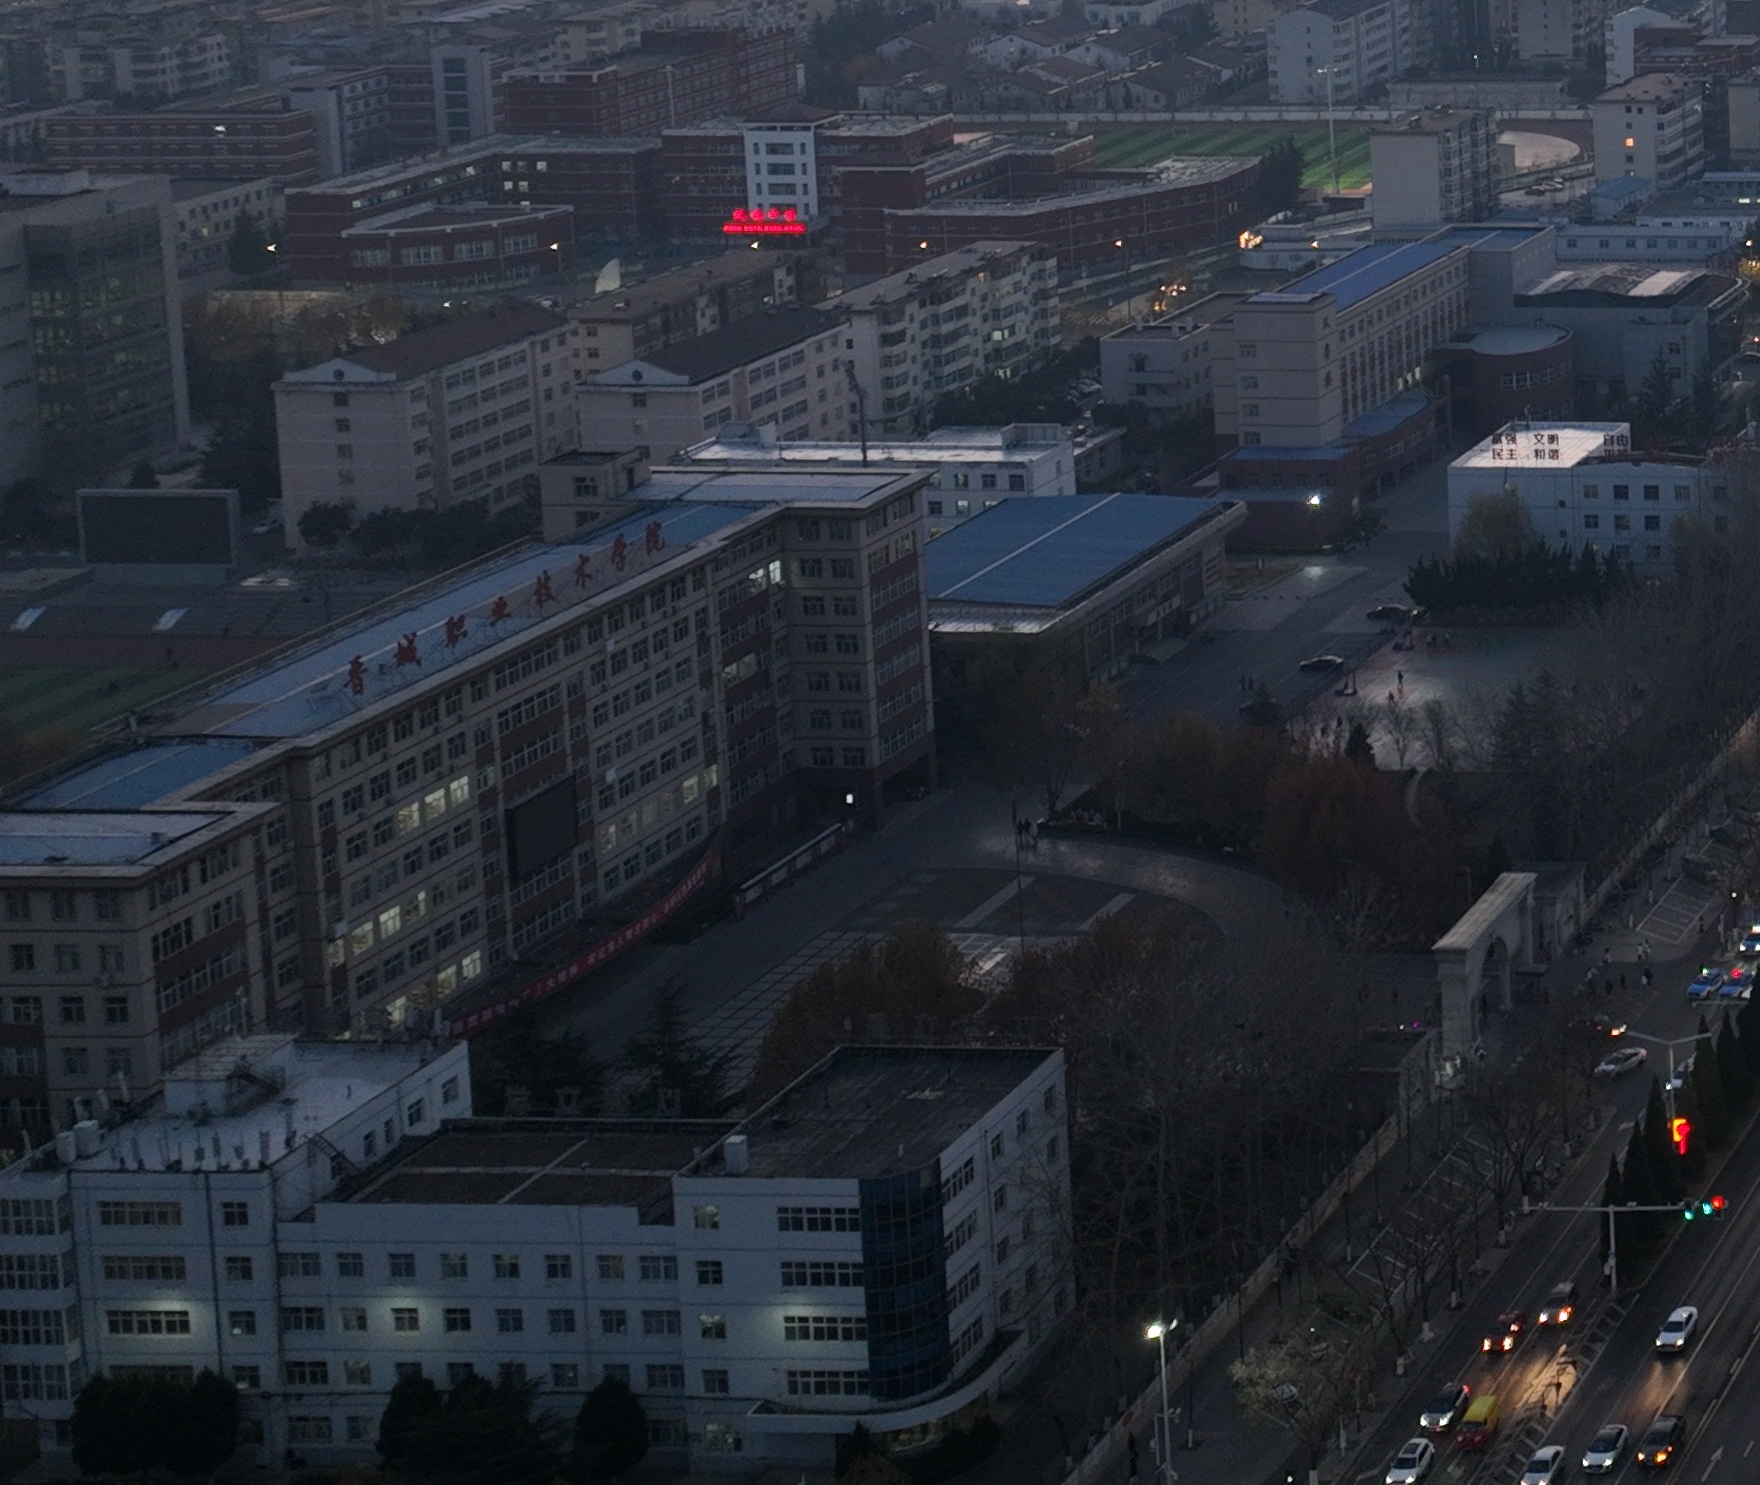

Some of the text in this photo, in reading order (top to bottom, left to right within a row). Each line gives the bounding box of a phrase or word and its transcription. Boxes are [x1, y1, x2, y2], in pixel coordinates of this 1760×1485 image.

[1533, 433, 1560, 445] 文明
[1603, 433, 1629, 446] 自由
[1492, 448, 1517, 460] 民主
[1533, 448, 1560, 461] 和谐
